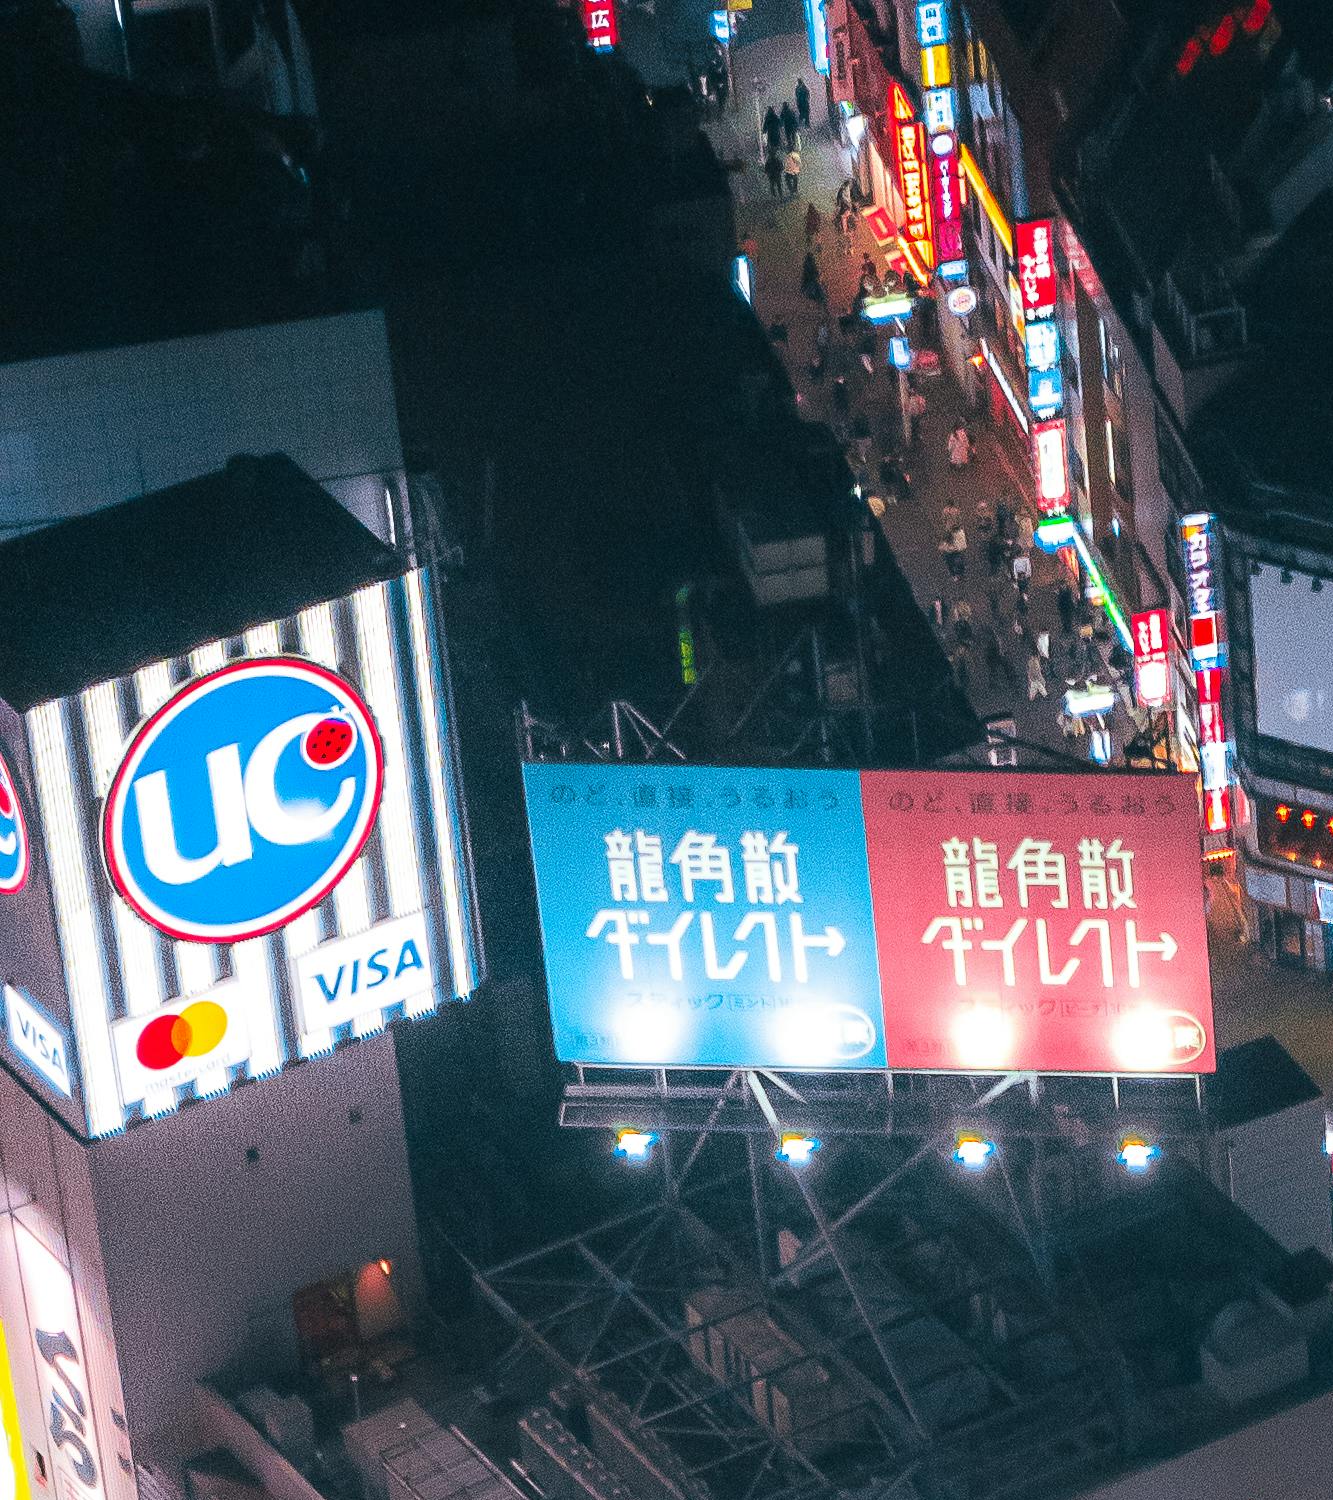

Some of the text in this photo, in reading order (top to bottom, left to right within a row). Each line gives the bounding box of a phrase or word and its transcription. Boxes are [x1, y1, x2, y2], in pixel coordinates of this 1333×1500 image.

[134, 711, 358, 886] UC
[604, 827, 804, 905] 龍角散
[941, 836, 1138, 911] 龍角散
[314, 937, 425, 1003] VISA
[584, 908, 847, 984] ダイレクト
[920, 916, 1179, 989] ダイレクト
[14, 1006, 66, 1075] VISA
